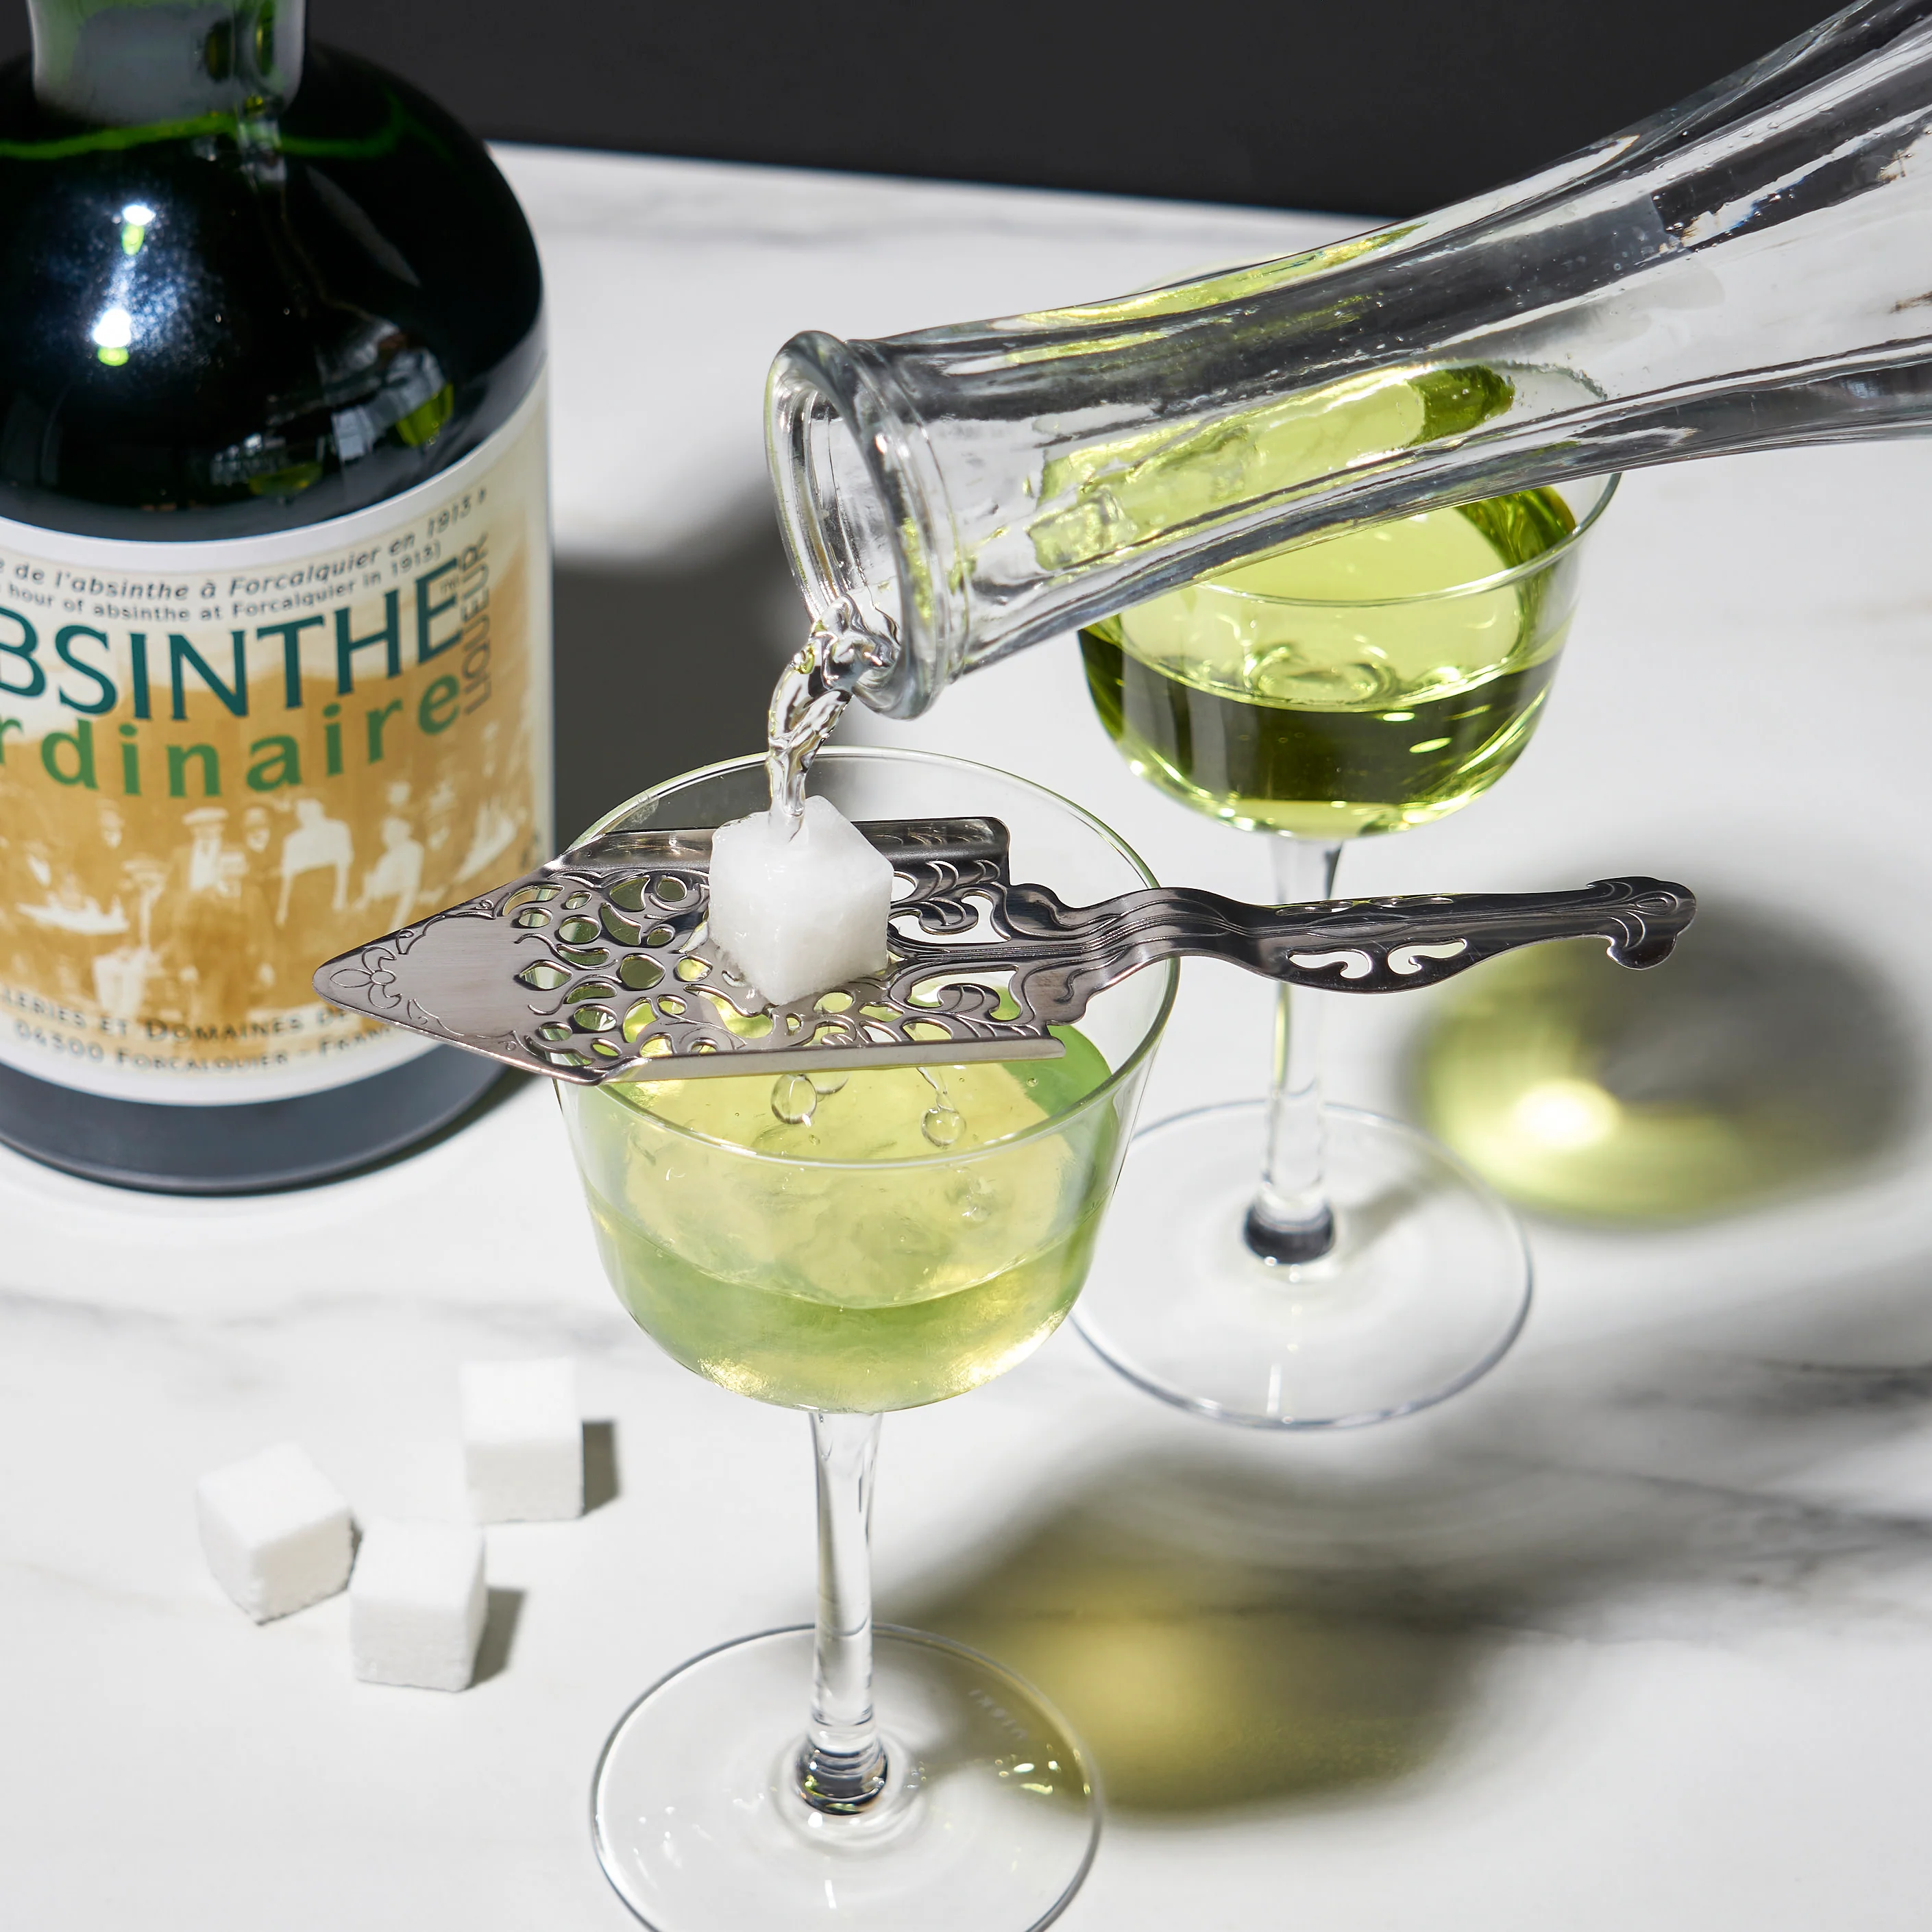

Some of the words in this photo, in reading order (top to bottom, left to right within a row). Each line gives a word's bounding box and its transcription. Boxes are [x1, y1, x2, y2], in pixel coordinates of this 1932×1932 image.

[15, 562, 45, 585] de
[55, 569, 188, 600] l'absinthe
[201, 581, 217, 600] à
[228, 546, 380, 597] Forcalquier
[389, 532, 416, 557] en
[427, 494, 472, 539] 1913
[8, 582, 55, 609] hour
[63, 596, 83, 614] of
[93, 598, 191, 622] absinthe
[201, 604, 221, 621] at
[232, 578, 356, 618] Forcalquier
[363, 570, 381, 590] in
[462, 531, 492, 716] LIQUEUR
[100, 1014, 128, 1038] ET
